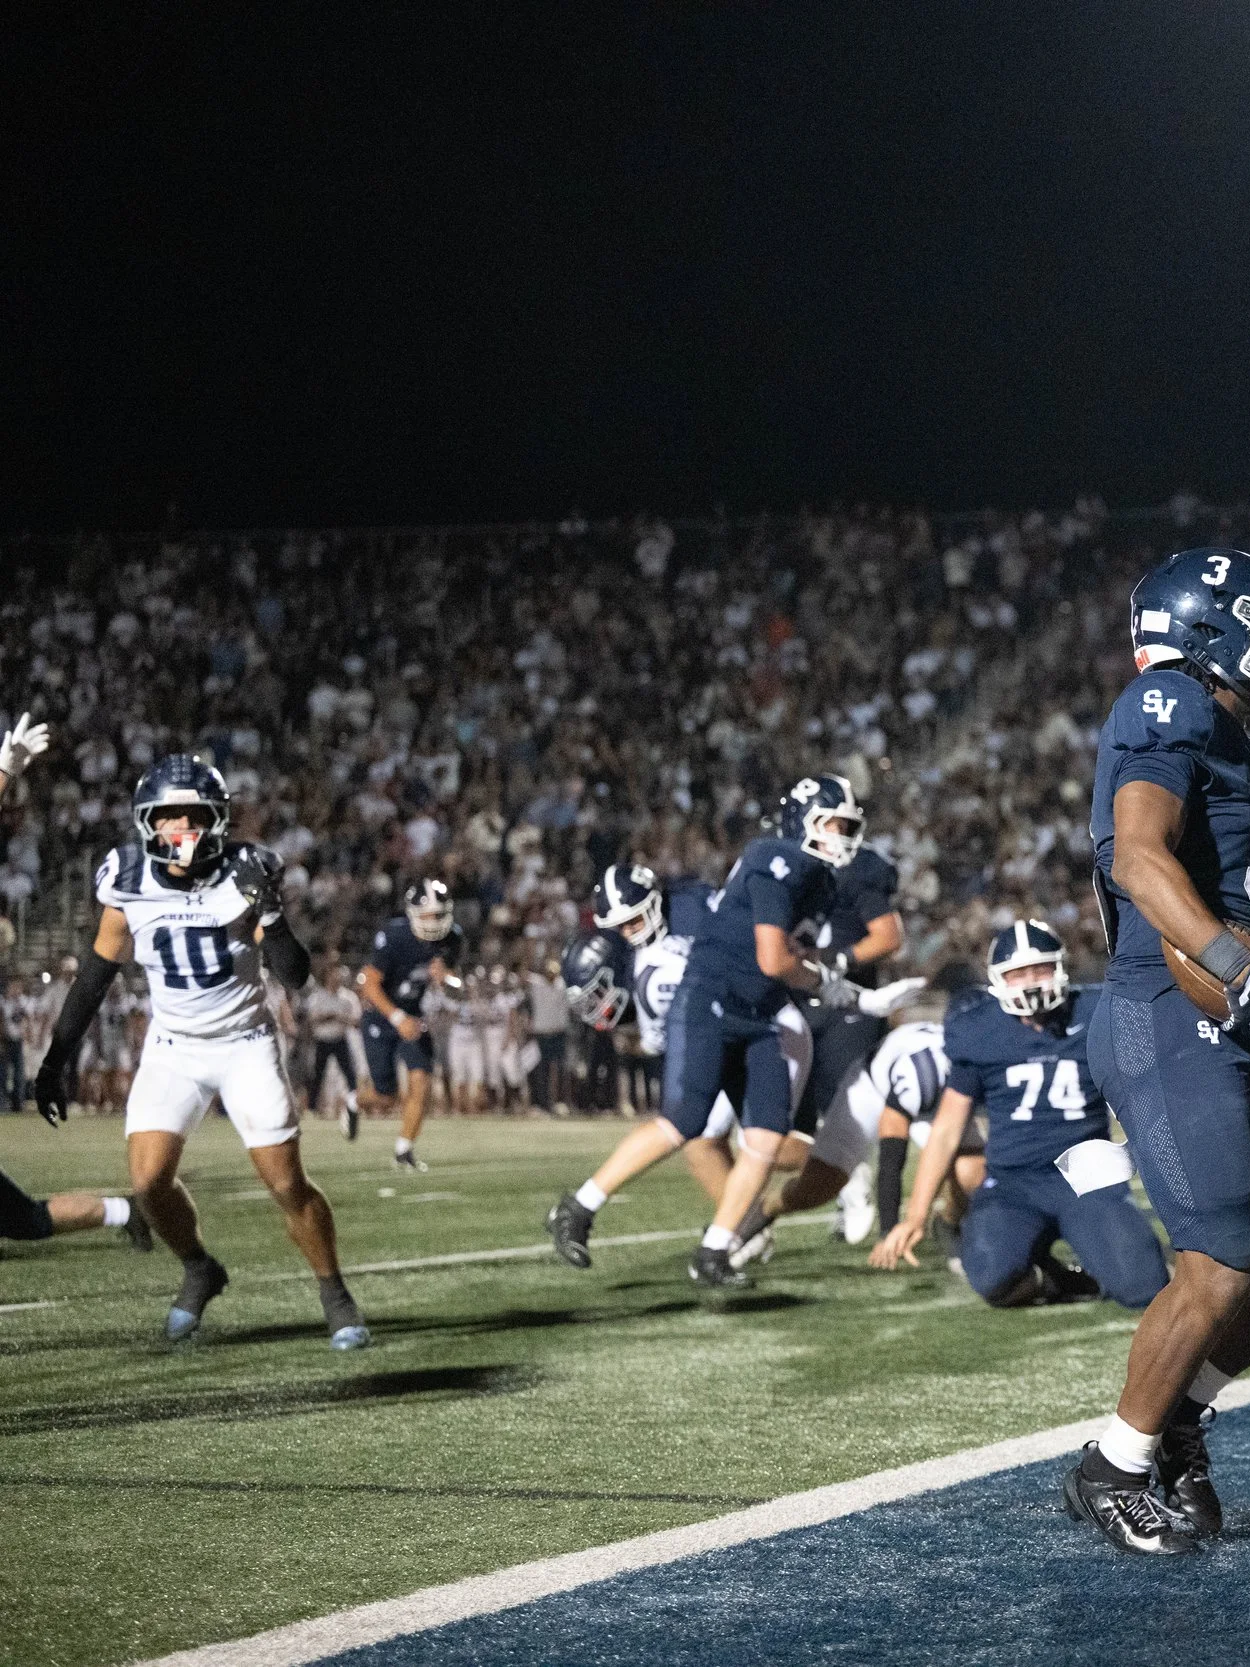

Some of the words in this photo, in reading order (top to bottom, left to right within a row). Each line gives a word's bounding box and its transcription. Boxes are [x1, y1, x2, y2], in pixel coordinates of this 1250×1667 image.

[1201, 556, 1231, 586] 3
[1143, 689, 1178, 723] SV
[152, 926, 234, 990] 10
[1006, 1059, 1087, 1121] 74
